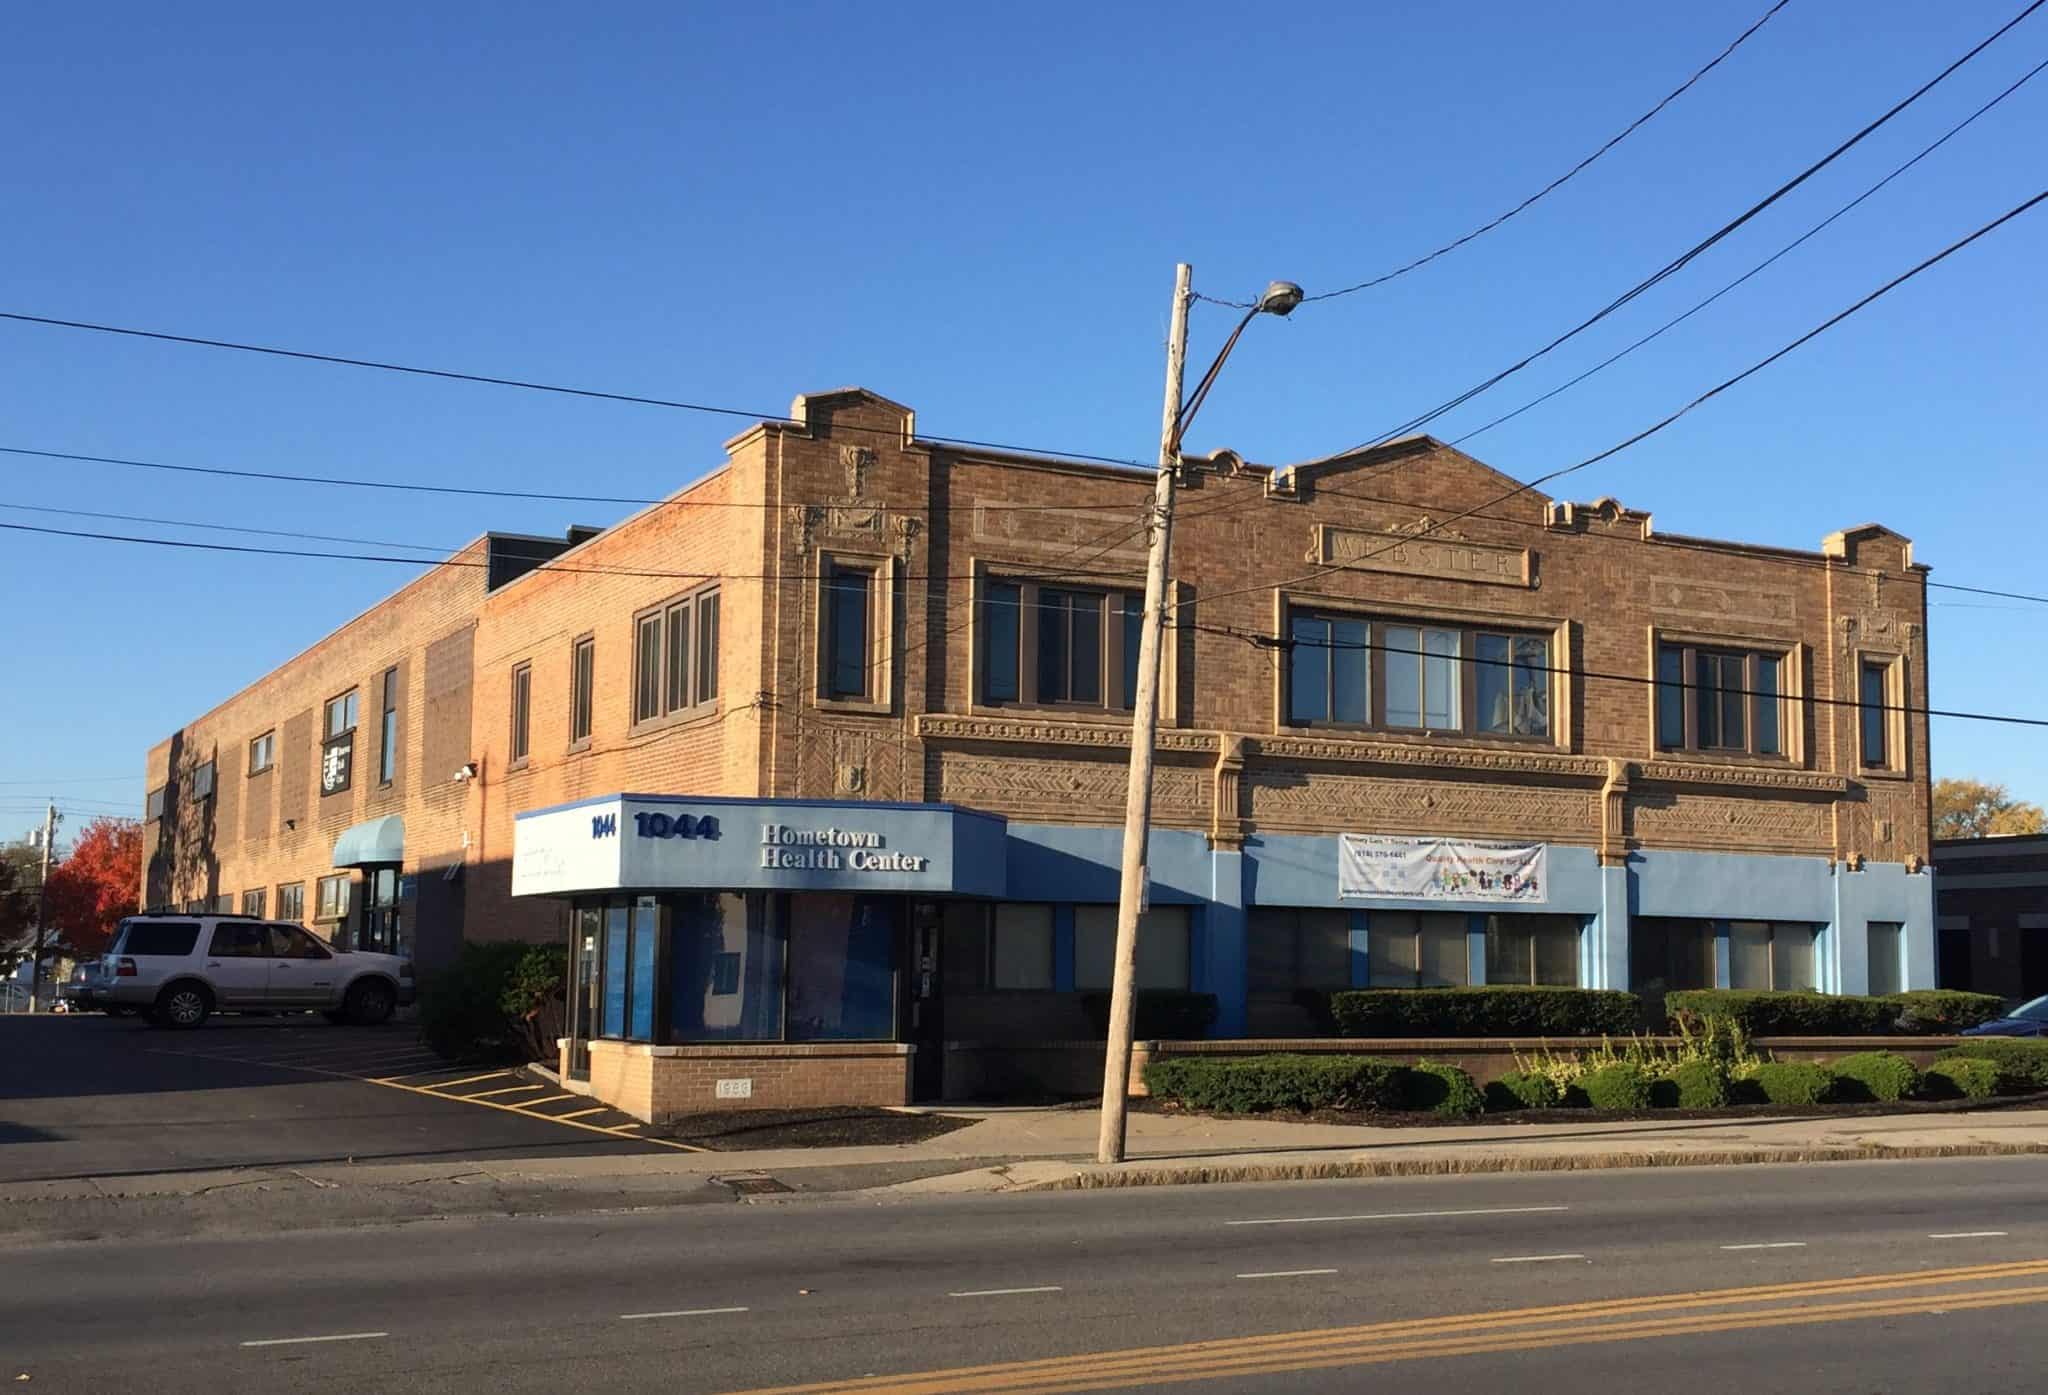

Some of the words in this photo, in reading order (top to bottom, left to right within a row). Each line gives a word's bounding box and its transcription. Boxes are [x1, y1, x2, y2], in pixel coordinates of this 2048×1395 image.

[1335, 536, 1511, 574] WEBSTER
[592, 813, 617, 839] 1044
[634, 812, 721, 841] 1044
[760, 823, 881, 848] Hometown
[760, 847, 842, 870] Health
[849, 849, 926, 871] Center
